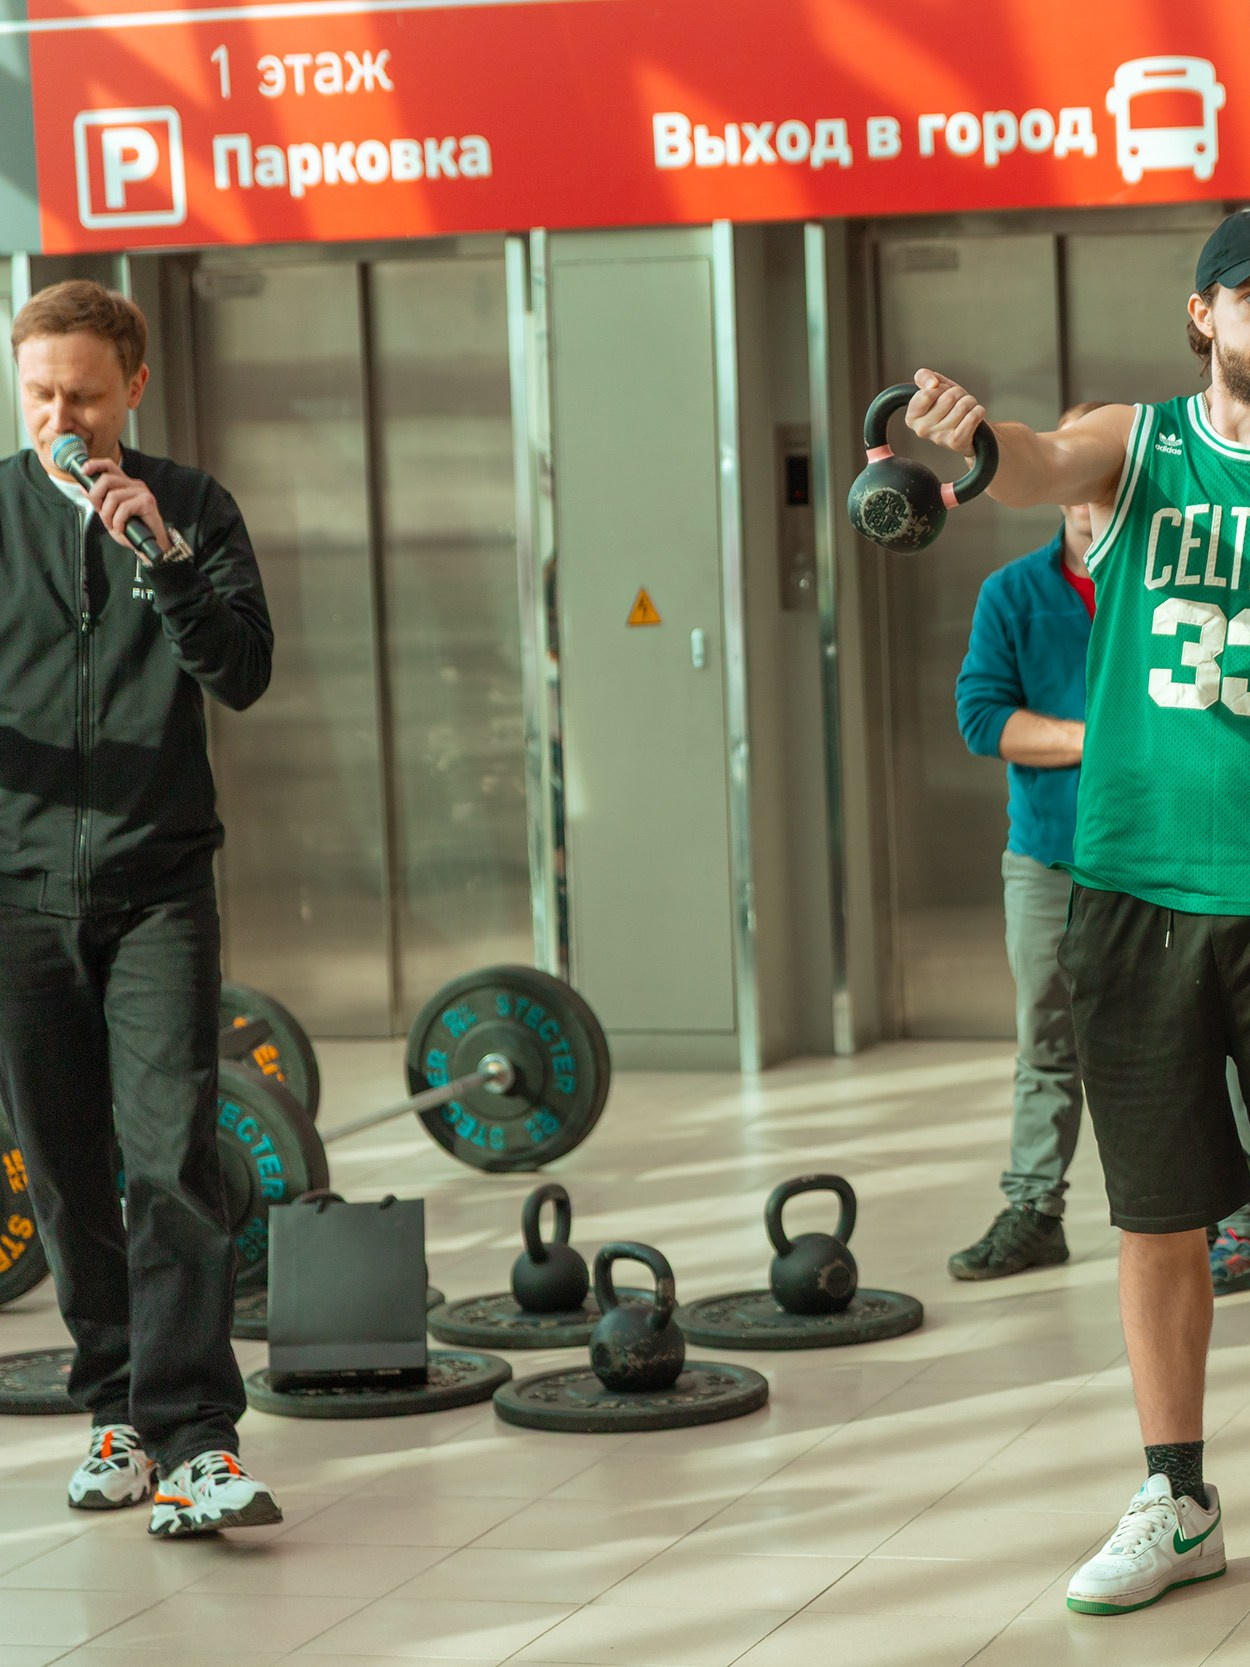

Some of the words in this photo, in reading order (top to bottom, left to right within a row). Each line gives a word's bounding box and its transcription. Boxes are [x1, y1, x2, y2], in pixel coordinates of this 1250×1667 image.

[211, 45, 232, 99] 1
[256, 49, 394, 97] этаж
[213, 134, 492, 197] Парковка
[652, 111, 852, 169] Выход
[866, 117, 900, 159] в
[918, 107, 1097, 166] город
[1155, 443, 1182, 456] adidas
[496, 994, 576, 1095] STECTER
[426, 1049, 504, 1150] STECER
[217, 1098, 286, 1200] ECTER
